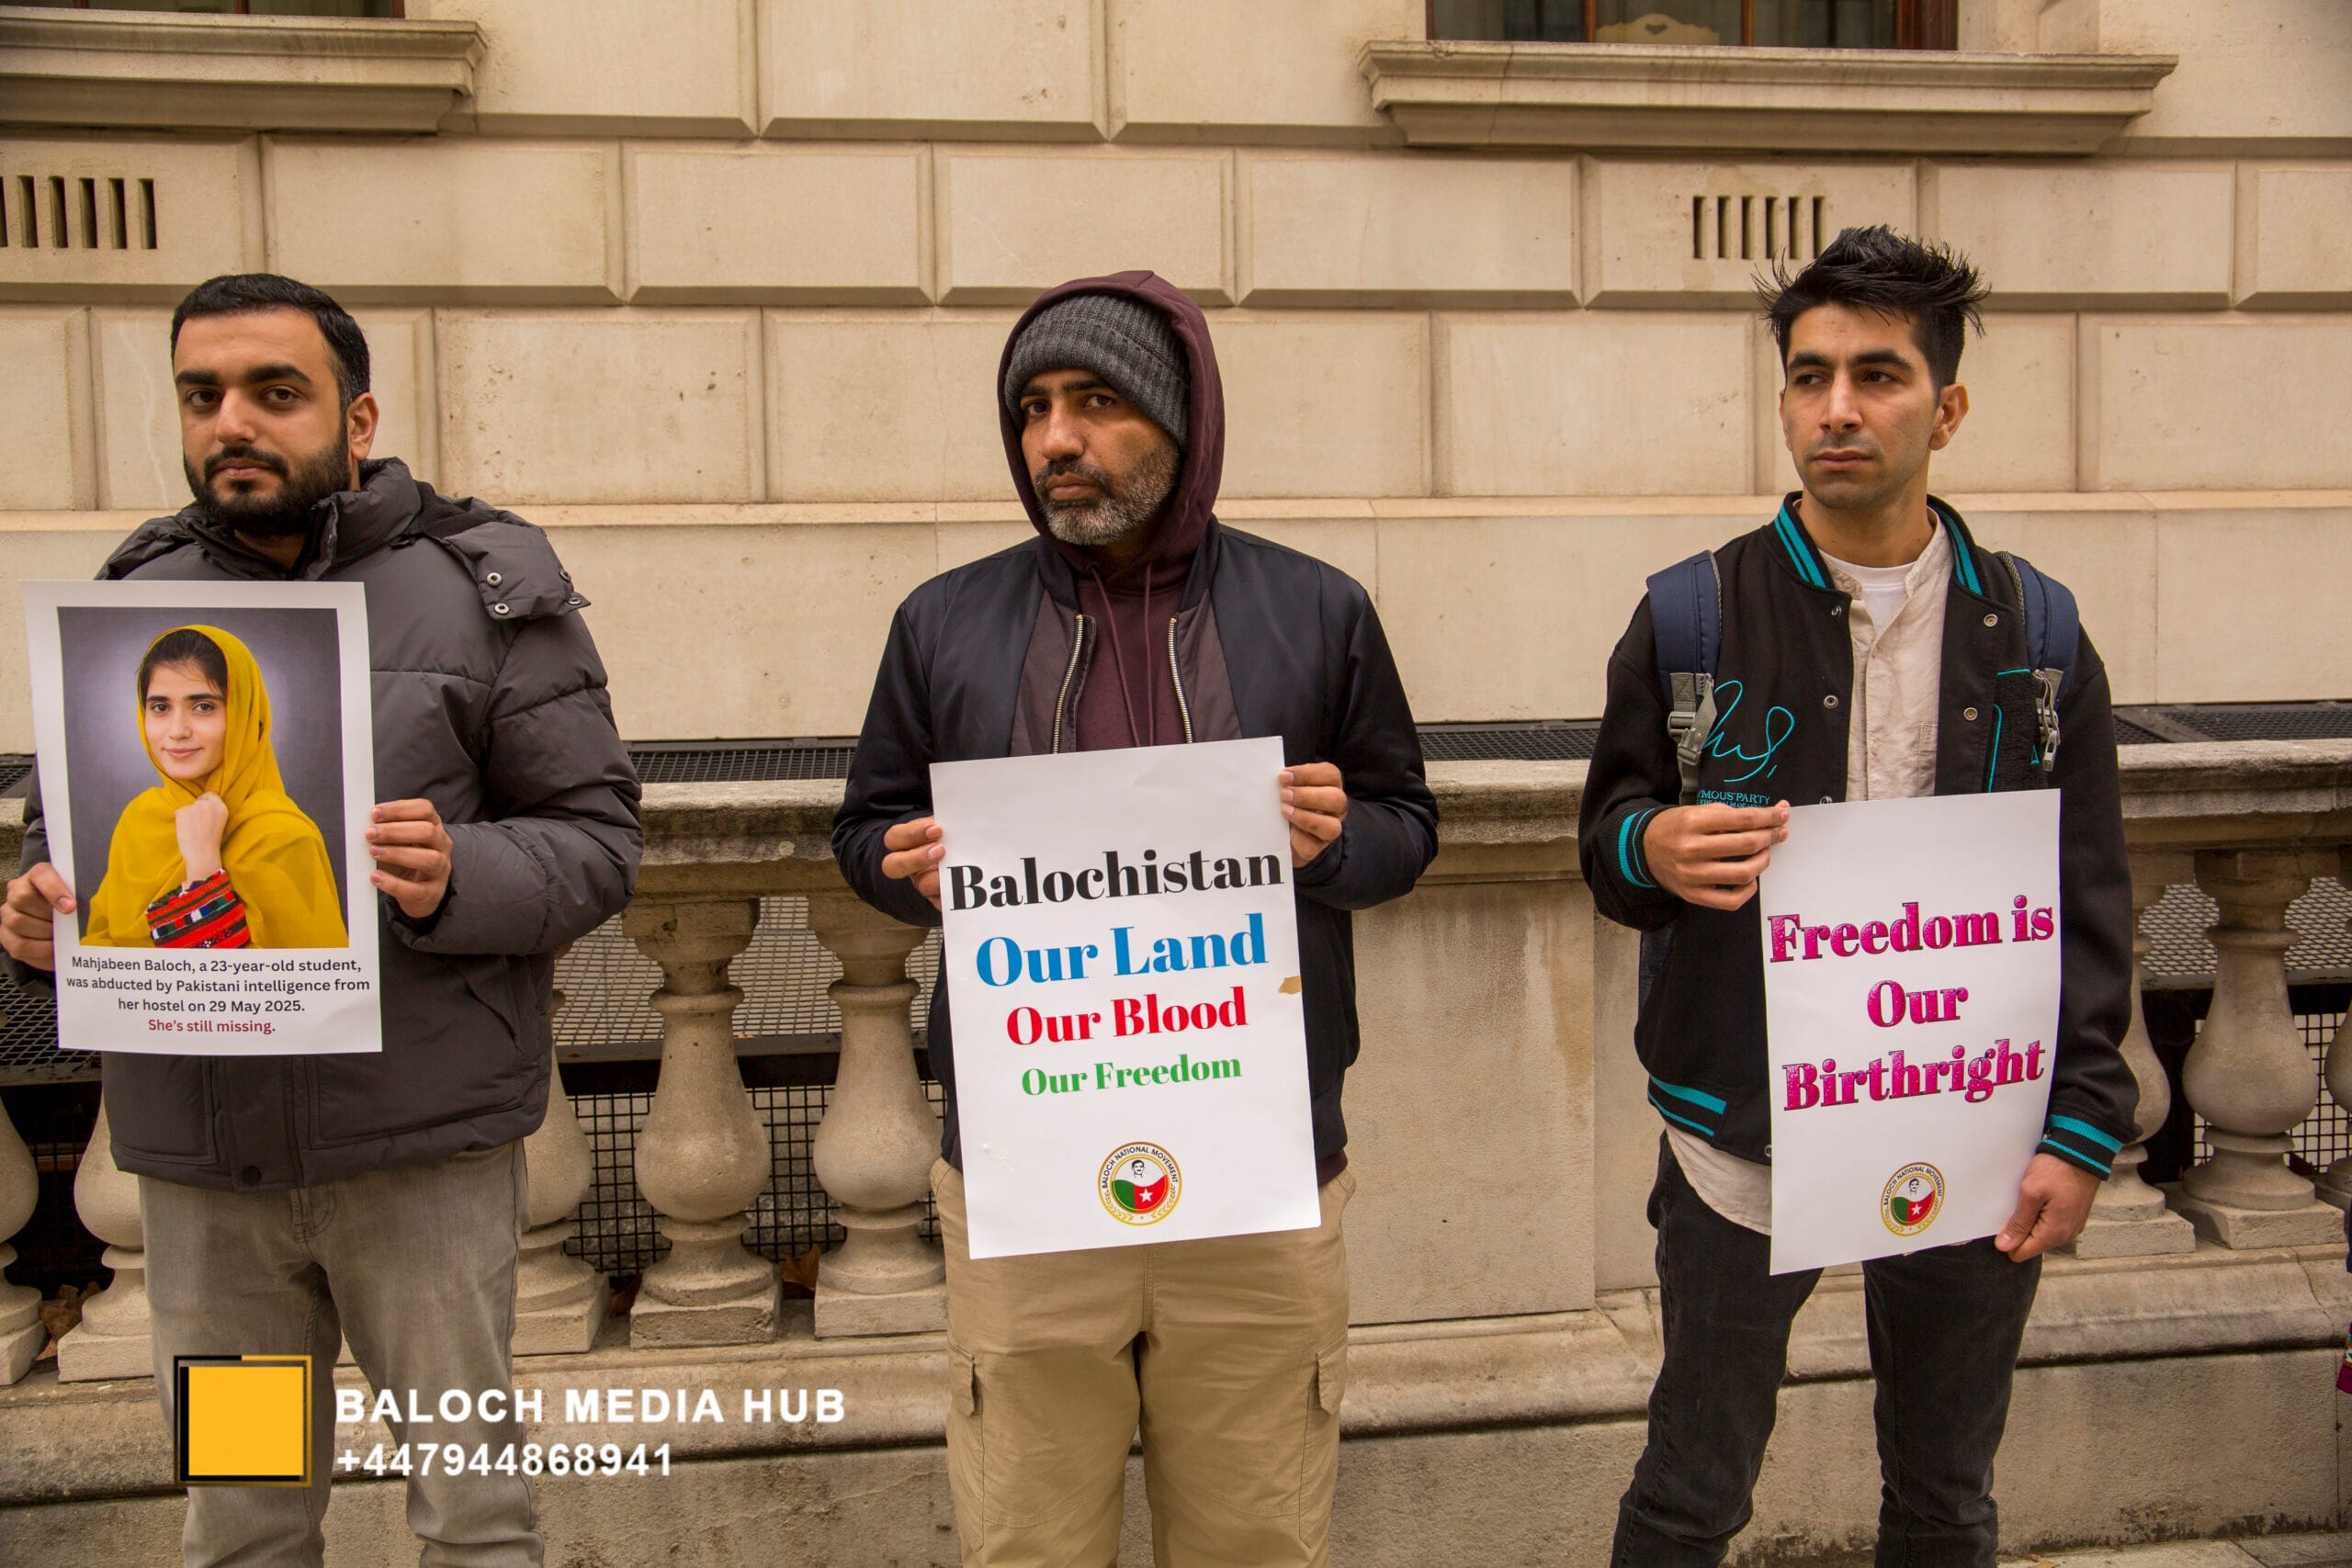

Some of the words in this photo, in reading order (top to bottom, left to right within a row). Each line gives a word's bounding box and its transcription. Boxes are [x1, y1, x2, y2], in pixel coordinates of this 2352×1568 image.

[1736, 793, 1770, 805] PARTY
[946, 849, 1284, 911] Balochistan
[976, 936, 1099, 987] Our
[1110, 912, 1270, 976] Land
[1767, 901, 2003, 963] Freedom
[2011, 895, 2054, 942] is
[66, 977, 89, 988] was
[91, 977, 153, 991] abducted
[156, 979, 173, 995] by
[176, 979, 241, 992] Pakistani
[243, 979, 331, 995] intelligence
[334, 978, 370, 991] from
[72, 956, 141, 972] Mahjabeen
[144, 959, 197, 973] Baloch,
[198, 962, 208, 972] a
[210, 960, 295, 975] 23-year-old
[299, 959, 362, 973] student,
[118, 998, 140, 1010] her
[142, 998, 186, 1012] hostel
[187, 1002, 206, 1012] on
[209, 1000, 227, 1012] 29
[231, 1000, 261, 1015] May
[265, 999, 305, 1012] 2025.
[1007, 1005, 1102, 1045] Our
[1111, 986, 1250, 1038] Blood
[1866, 979, 1969, 1028] Our
[148, 1019, 184, 1032] She’s
[187, 1019, 213, 1032] still
[216, 1021, 276, 1035] missing.
[1022, 1067, 1089, 1096] Our
[1094, 1054, 1243, 1090] Freedom
[1782, 1039, 2046, 1111] Birthright
[1102, 1157, 1115, 1189] BALOCH
[1114, 1145, 1149, 1161] NATIONAL
[1150, 1148, 1178, 1183] MOVEMENT
[1883, 1179, 1898, 1205] BALOCH
[1896, 1166, 1925, 1180] NATIONAL
[1926, 1168, 1942, 1197] MOVEMENT
